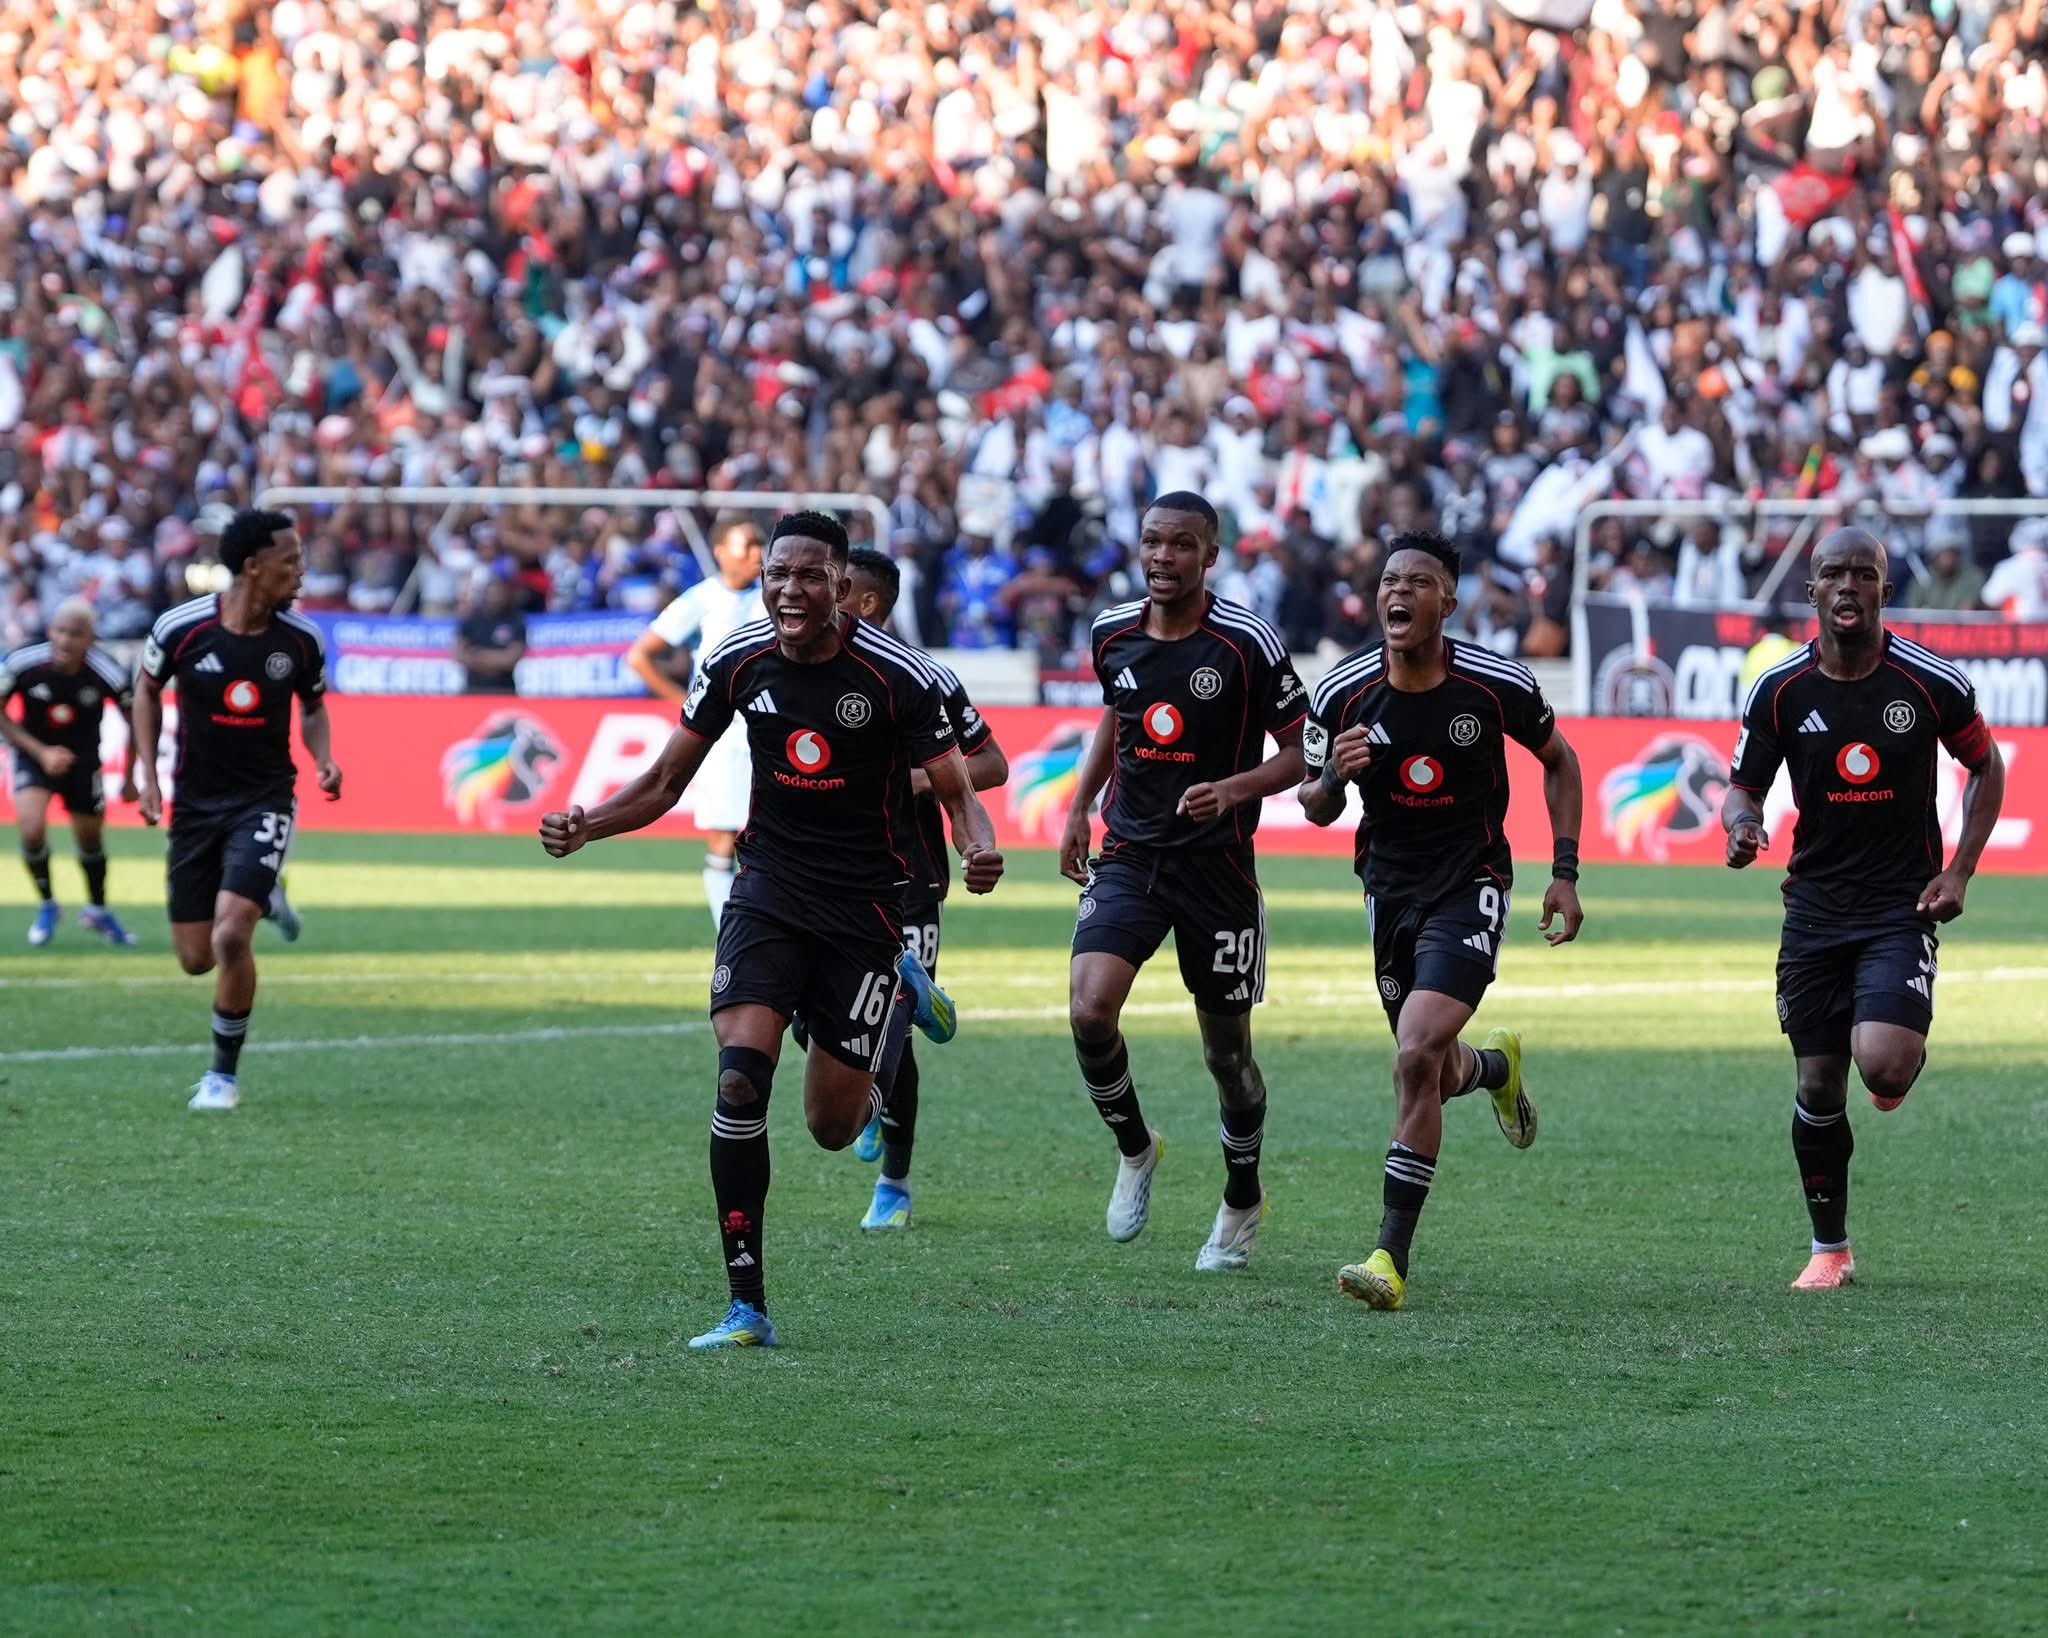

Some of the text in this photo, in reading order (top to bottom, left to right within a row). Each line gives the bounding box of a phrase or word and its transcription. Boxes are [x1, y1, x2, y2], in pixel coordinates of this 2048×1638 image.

[1276, 685, 1307, 710] SUZUK
[935, 724, 954, 739] SUZ
[1134, 746, 1196, 763] vodacom
[774, 771, 846, 791] vodacom
[1390, 791, 1454, 807] vodacom
[1827, 789, 1894, 802] vodacom
[253, 811, 291, 851] 33
[1478, 885, 1500, 933] 9
[902, 923, 939, 969] 38
[1212, 927, 1256, 975] 20
[848, 971, 890, 1026] 16
